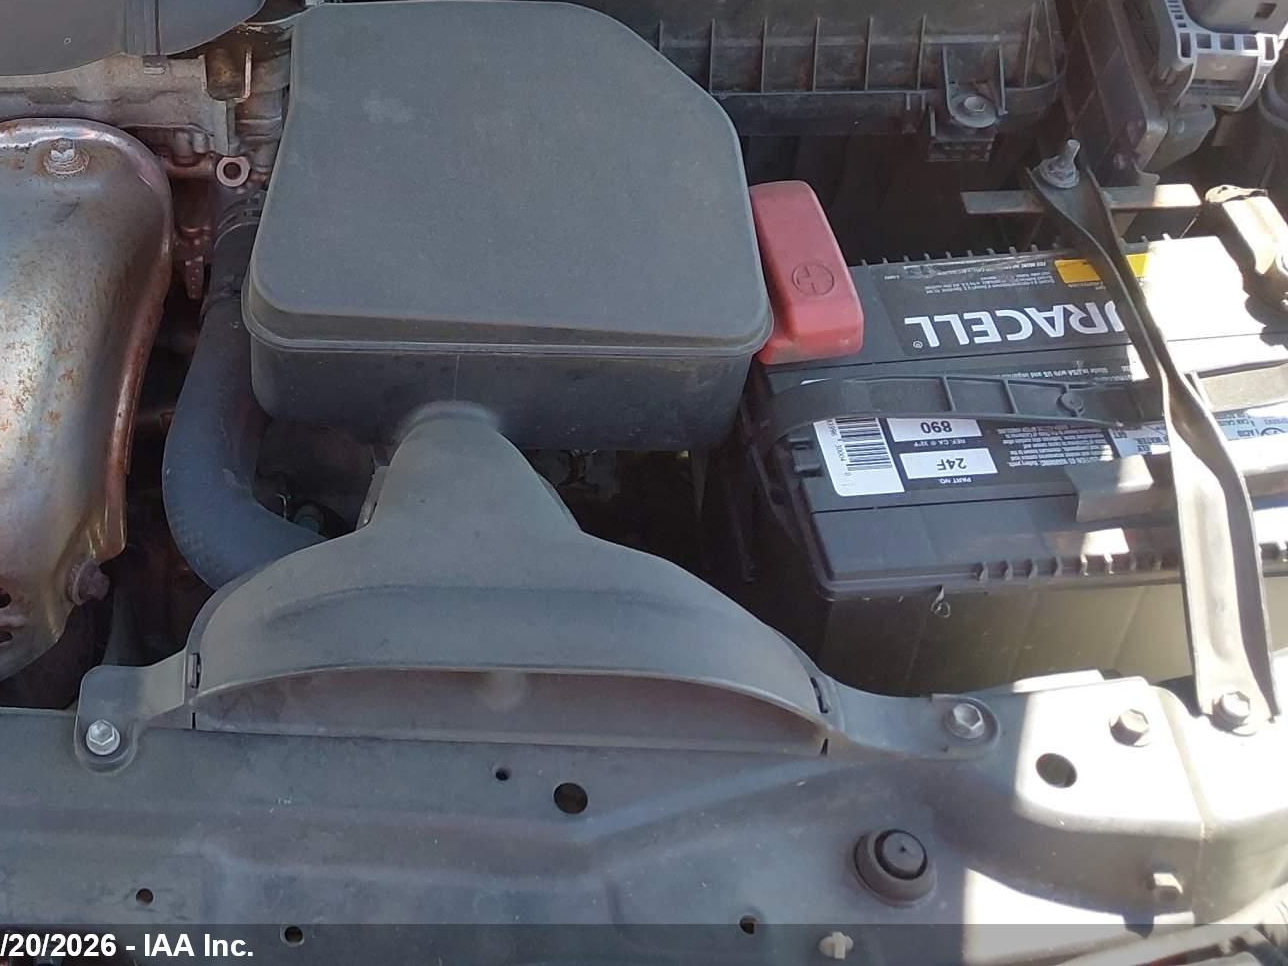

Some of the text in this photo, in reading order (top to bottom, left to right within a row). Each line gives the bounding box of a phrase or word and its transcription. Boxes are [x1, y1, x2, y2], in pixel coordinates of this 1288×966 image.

[904, 300, 1125, 348] RACELL
[920, 420, 953, 434] 890
[936, 457, 967, 471] 24F
[952, 476, 972, 484] PART
